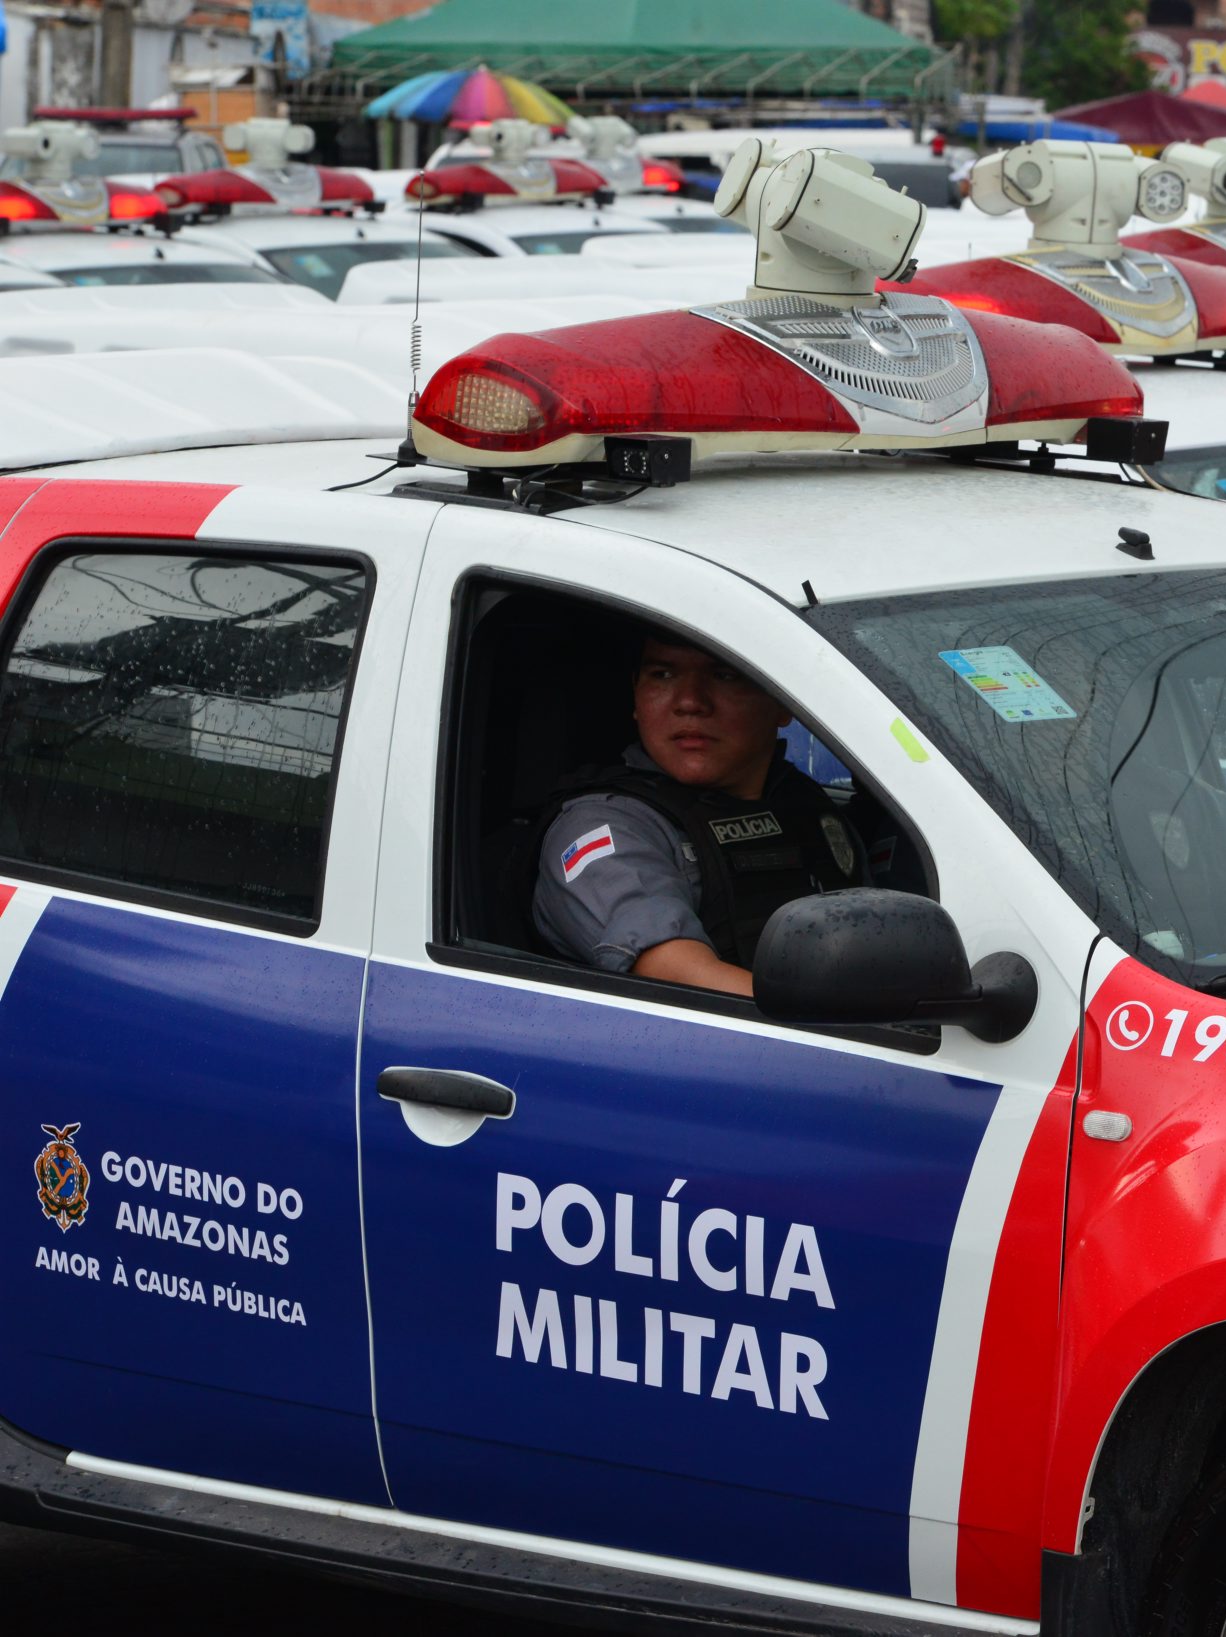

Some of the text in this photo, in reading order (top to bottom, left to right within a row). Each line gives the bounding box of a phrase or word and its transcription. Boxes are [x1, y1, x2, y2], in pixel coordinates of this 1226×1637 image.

[714, 817, 779, 842] POLÍCIA
[101, 1150, 304, 1220] GOVERNO DO
[115, 1201, 290, 1266] AMAZONAS
[495, 1172, 836, 1310] POLÍCIA
[35, 1246, 307, 1327] AMOR À CAUSA PÚBLICA
[495, 1281, 830, 1421] MILITAR
